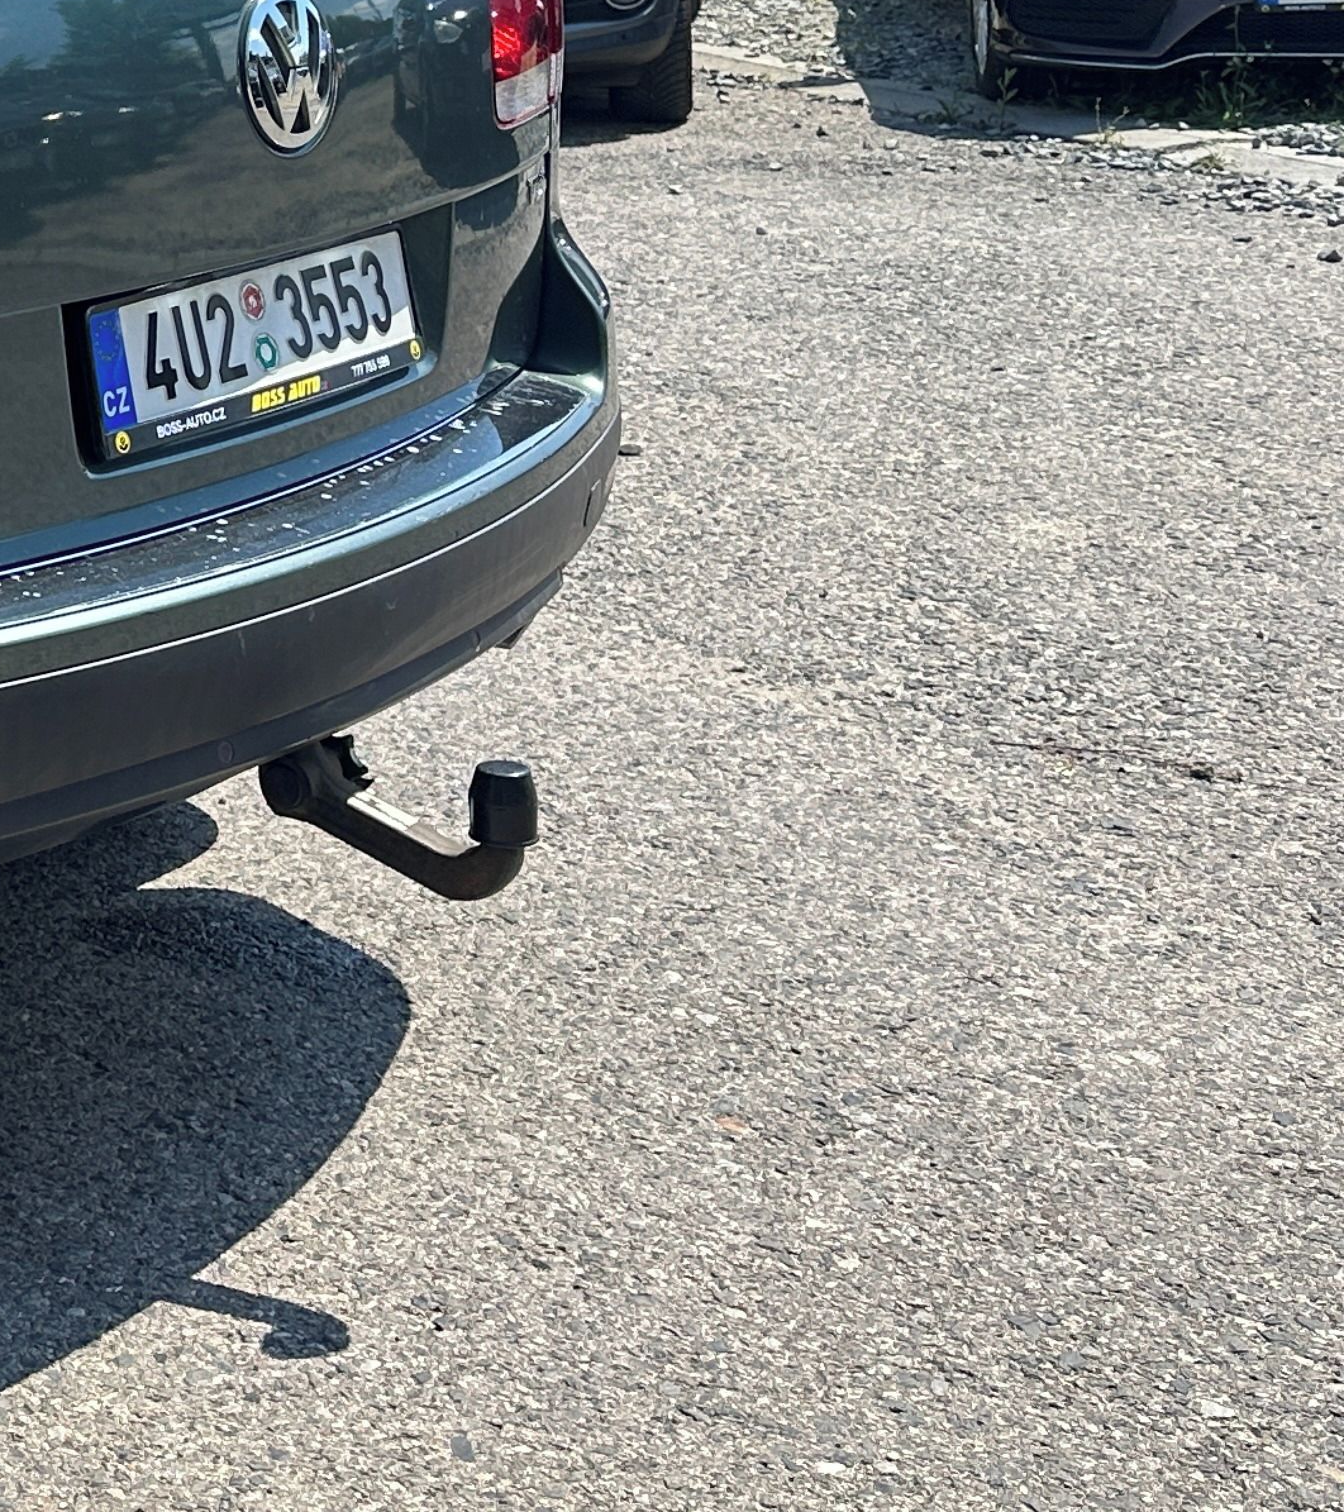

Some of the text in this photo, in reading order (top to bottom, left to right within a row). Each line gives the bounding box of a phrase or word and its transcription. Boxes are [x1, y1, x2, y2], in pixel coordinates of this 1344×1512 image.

[145, 250, 392, 400] 4U2 3553
[103, 386, 130, 417] CZ
[251, 375, 321, 413] BOSS AUTO
[156, 406, 227, 439] BOSS-AUTO.CZ
